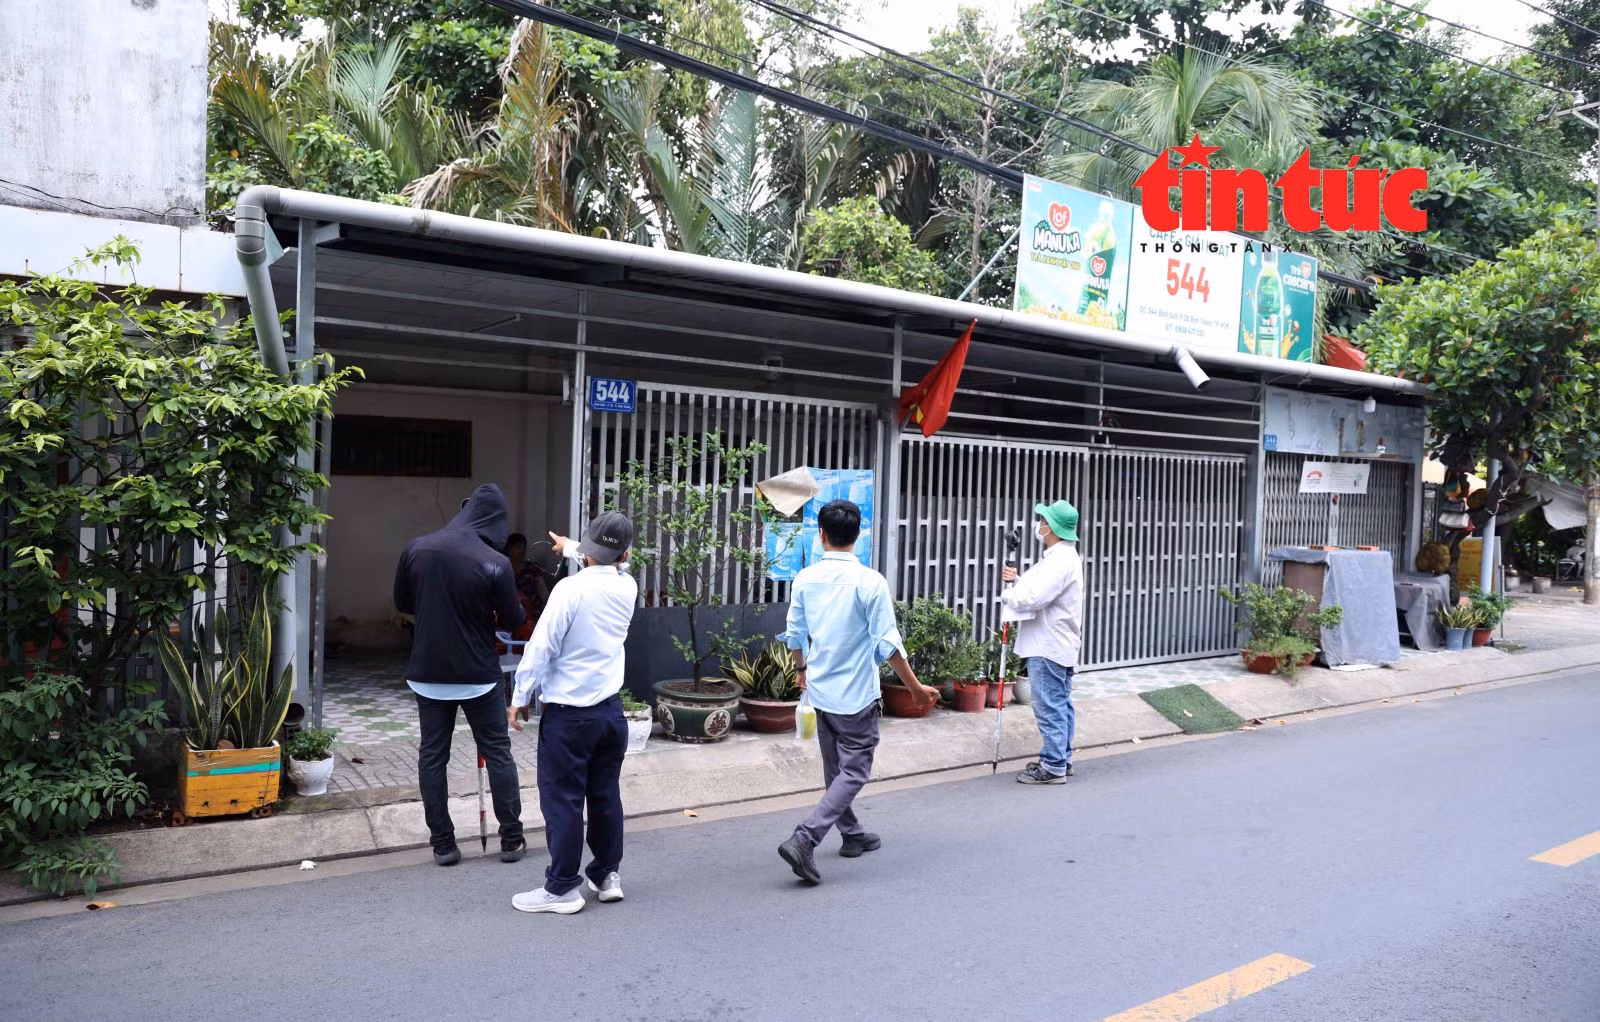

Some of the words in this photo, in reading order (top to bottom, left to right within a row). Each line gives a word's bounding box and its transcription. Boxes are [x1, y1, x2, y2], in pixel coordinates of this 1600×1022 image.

[1033, 226, 1081, 254] MANUKA
[1167, 258, 1210, 303] 544
[596, 380, 630, 403] 544
